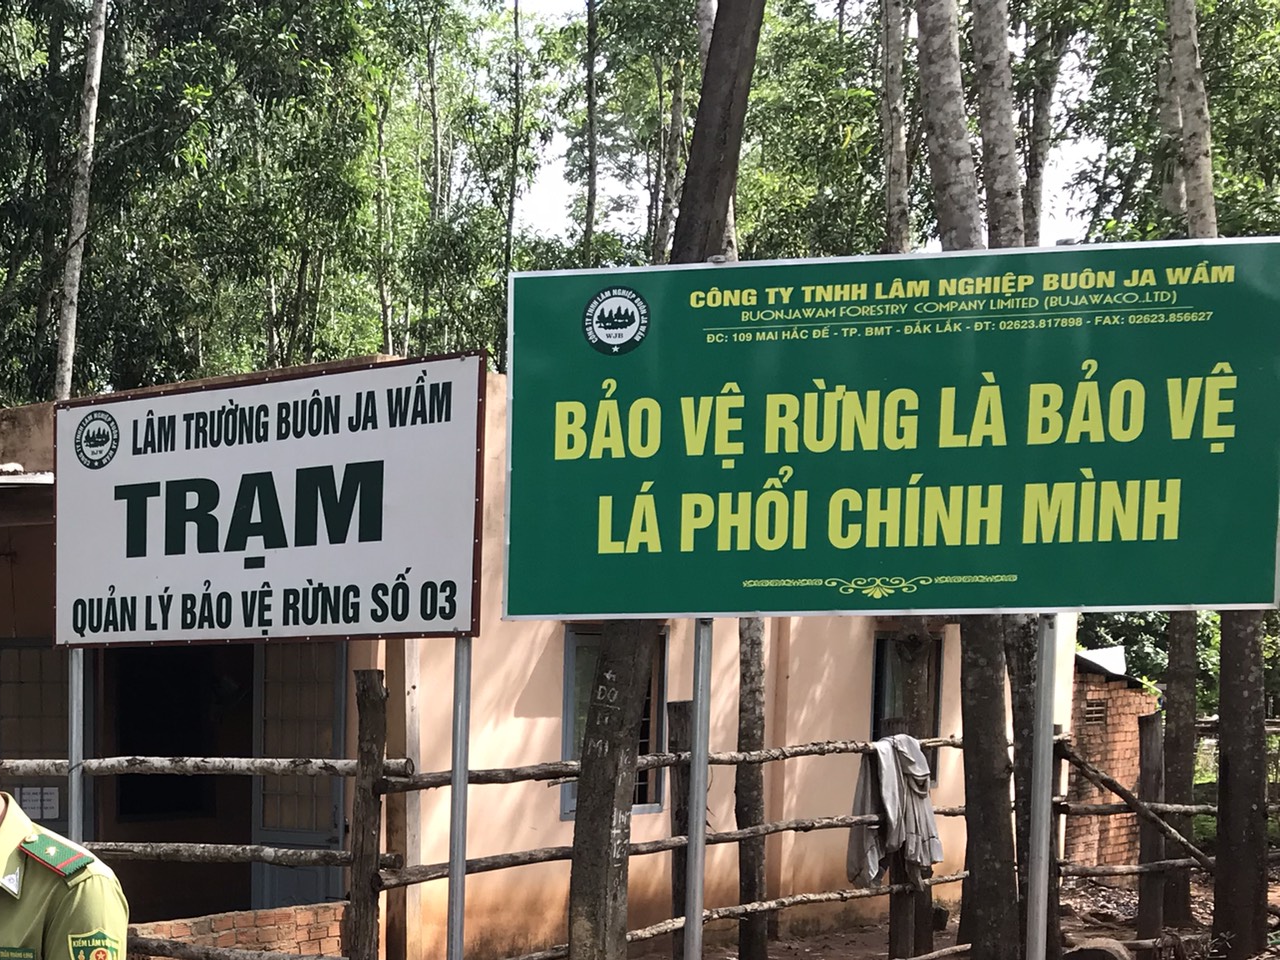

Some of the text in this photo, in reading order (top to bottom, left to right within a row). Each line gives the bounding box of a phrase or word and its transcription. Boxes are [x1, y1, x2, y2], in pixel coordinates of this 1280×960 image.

[690, 260, 1236, 308] CÔNG TY TNHH LÂM NGHIỆP BUÔN JA WẦM
[740, 307, 837, 322] BUONJAWAM
[839, 303, 909, 317] FORESTRY
[914, 299, 988, 314] COMPANY
[990, 297, 1040, 311] LIMITED
[706, 332, 728, 344] ĐC:
[732, 332, 753, 343] 109
[756, 332, 778, 342] MAI
[812, 325, 831, 338] ĐẾ
[841, 327, 862, 338] TP.
[864, 326, 893, 336] BMT
[974, 321, 996, 332] ĐT:
[999, 317, 1083, 330] 02623.817898
[1094, 315, 1125, 326] FAX:
[1128, 312, 1214, 324] 02623.856627
[132, 369, 453, 456] LÂM TRƯỜNG BUÔN JA WẦM
[554, 358, 1238, 469] BẢO VỆ RỪNG LÀ BẢO VỆ
[113, 460, 385, 570] TRẠM
[598, 465, 1182, 554] LÁ PHỔI CHÍNH MÌNH
[72, 567, 458, 638] QUẢN LÝ BẢO VỆ RỪNG SỐ 03
